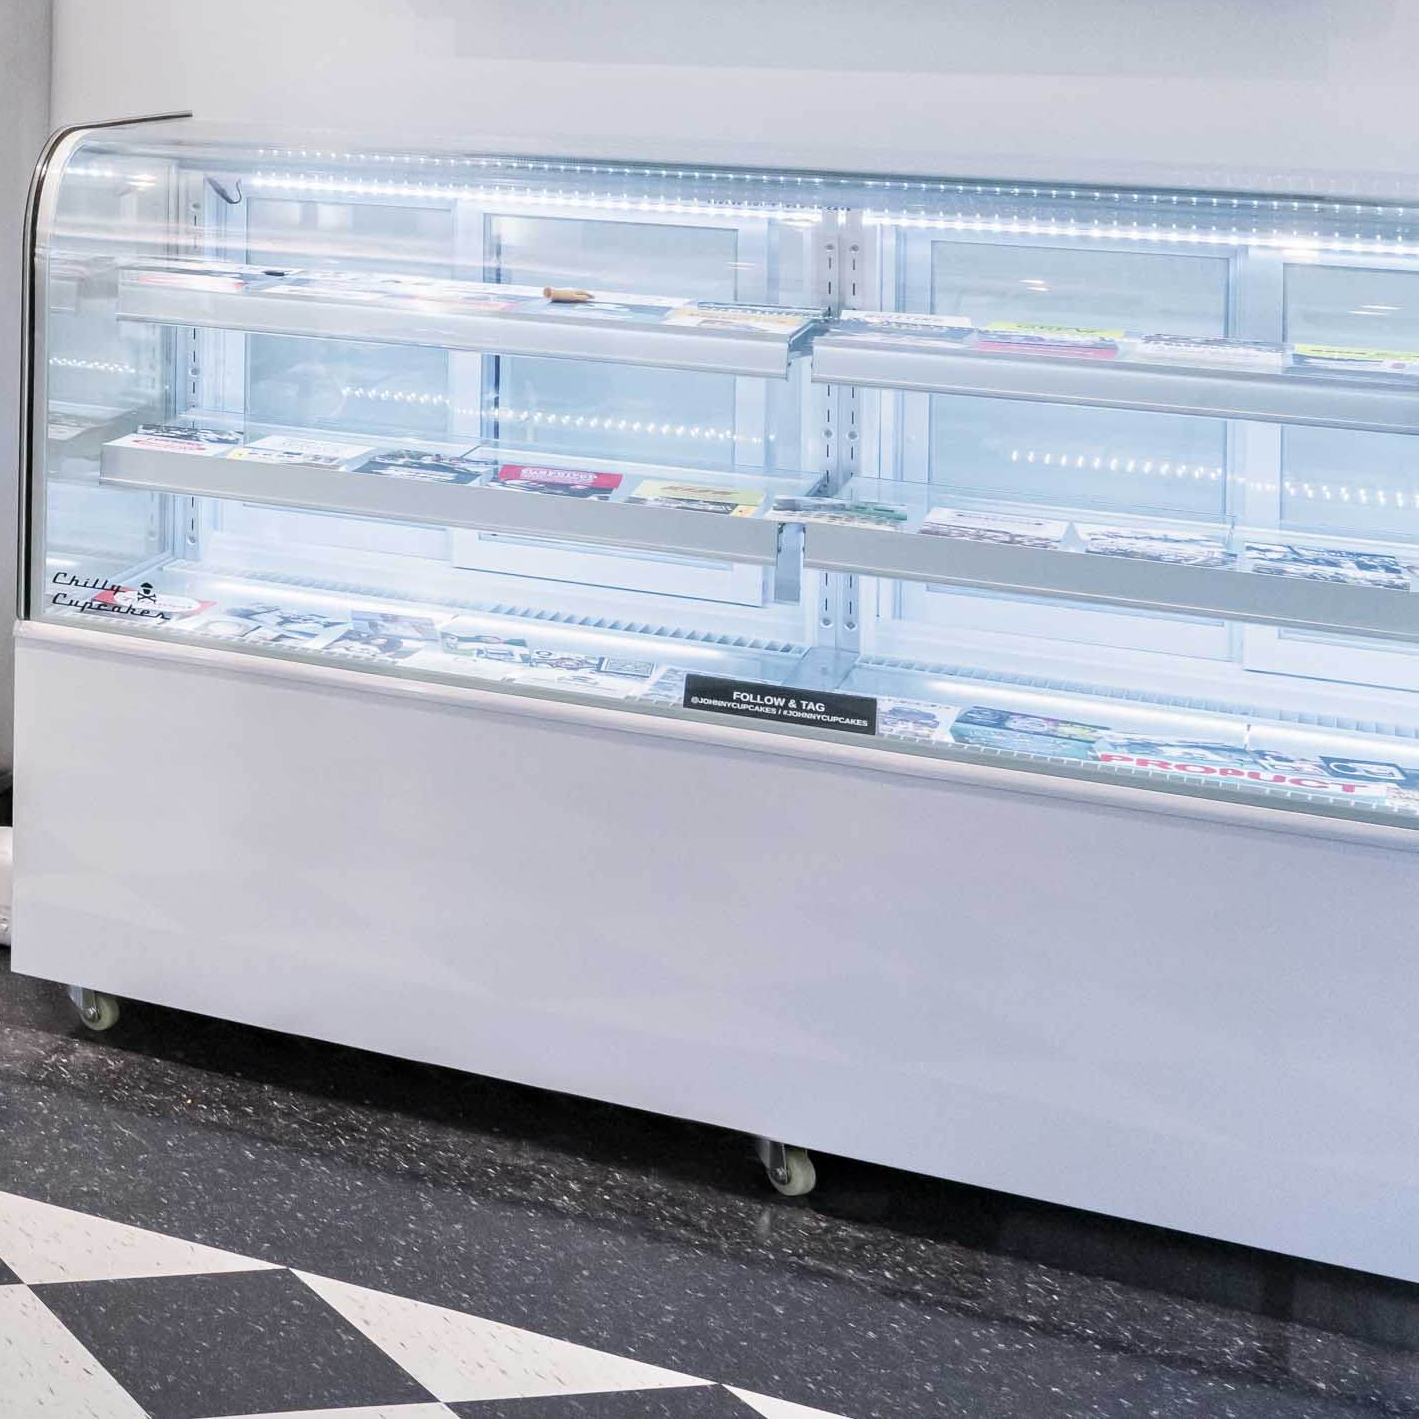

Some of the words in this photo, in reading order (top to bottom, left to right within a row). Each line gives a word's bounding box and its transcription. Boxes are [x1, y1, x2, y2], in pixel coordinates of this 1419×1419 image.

[52, 572, 127, 595] Chilly
[52, 592, 171, 621] Cupcakes
[732, 691, 786, 707] FOLLOW
[788, 699, 797, 709] &
[800, 700, 825, 712] TAG
